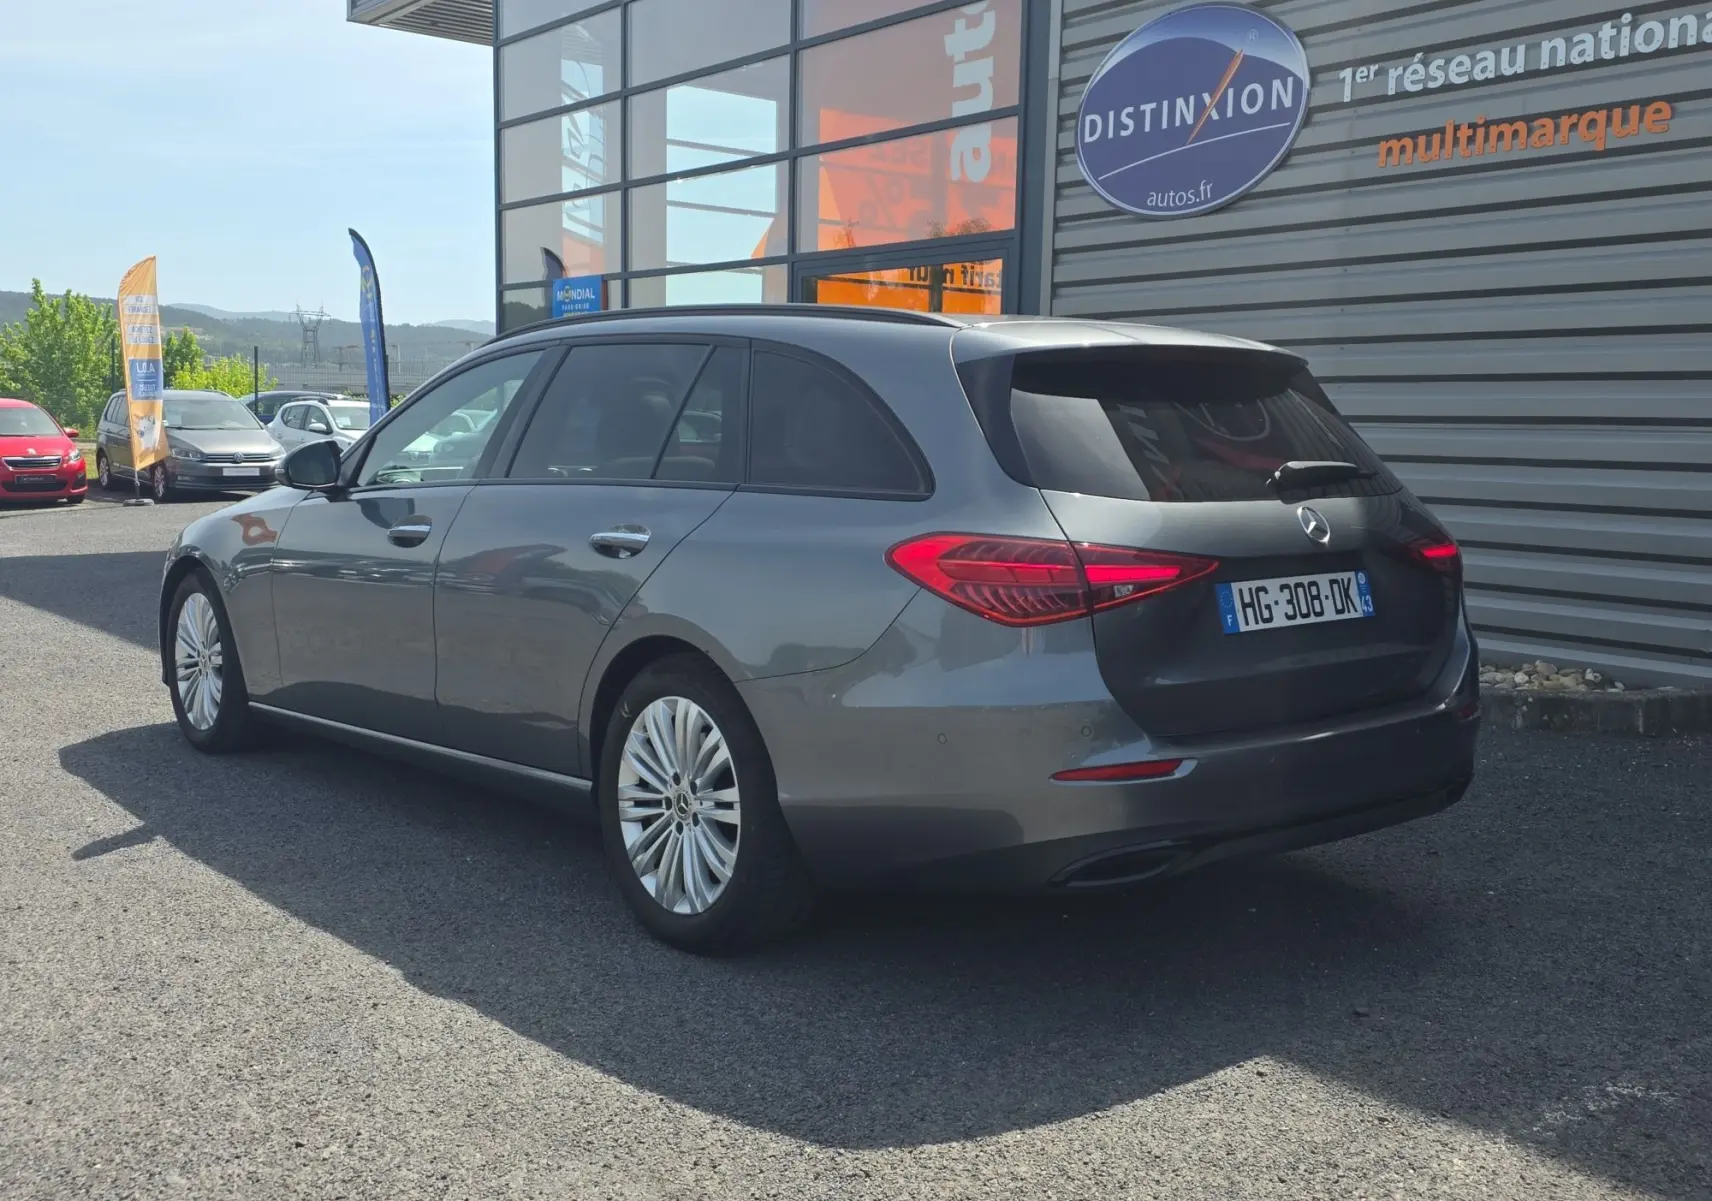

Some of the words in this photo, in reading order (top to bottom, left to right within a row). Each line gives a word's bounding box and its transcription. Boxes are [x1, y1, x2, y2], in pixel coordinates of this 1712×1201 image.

[944, 0, 996, 183] aut
[1339, 62, 1379, 102] 1er
[1387, 52, 1526, 96] réseau
[1083, 76, 1294, 143] DISTINXION
[1377, 100, 1672, 168] multimarque
[1146, 179, 1213, 207] autos.fr
[556, 285, 596, 302] MONDIAL
[1227, 615, 1233, 627] F
[1238, 577, 1358, 627] HG-308-DK
[1361, 594, 1374, 613] 43
